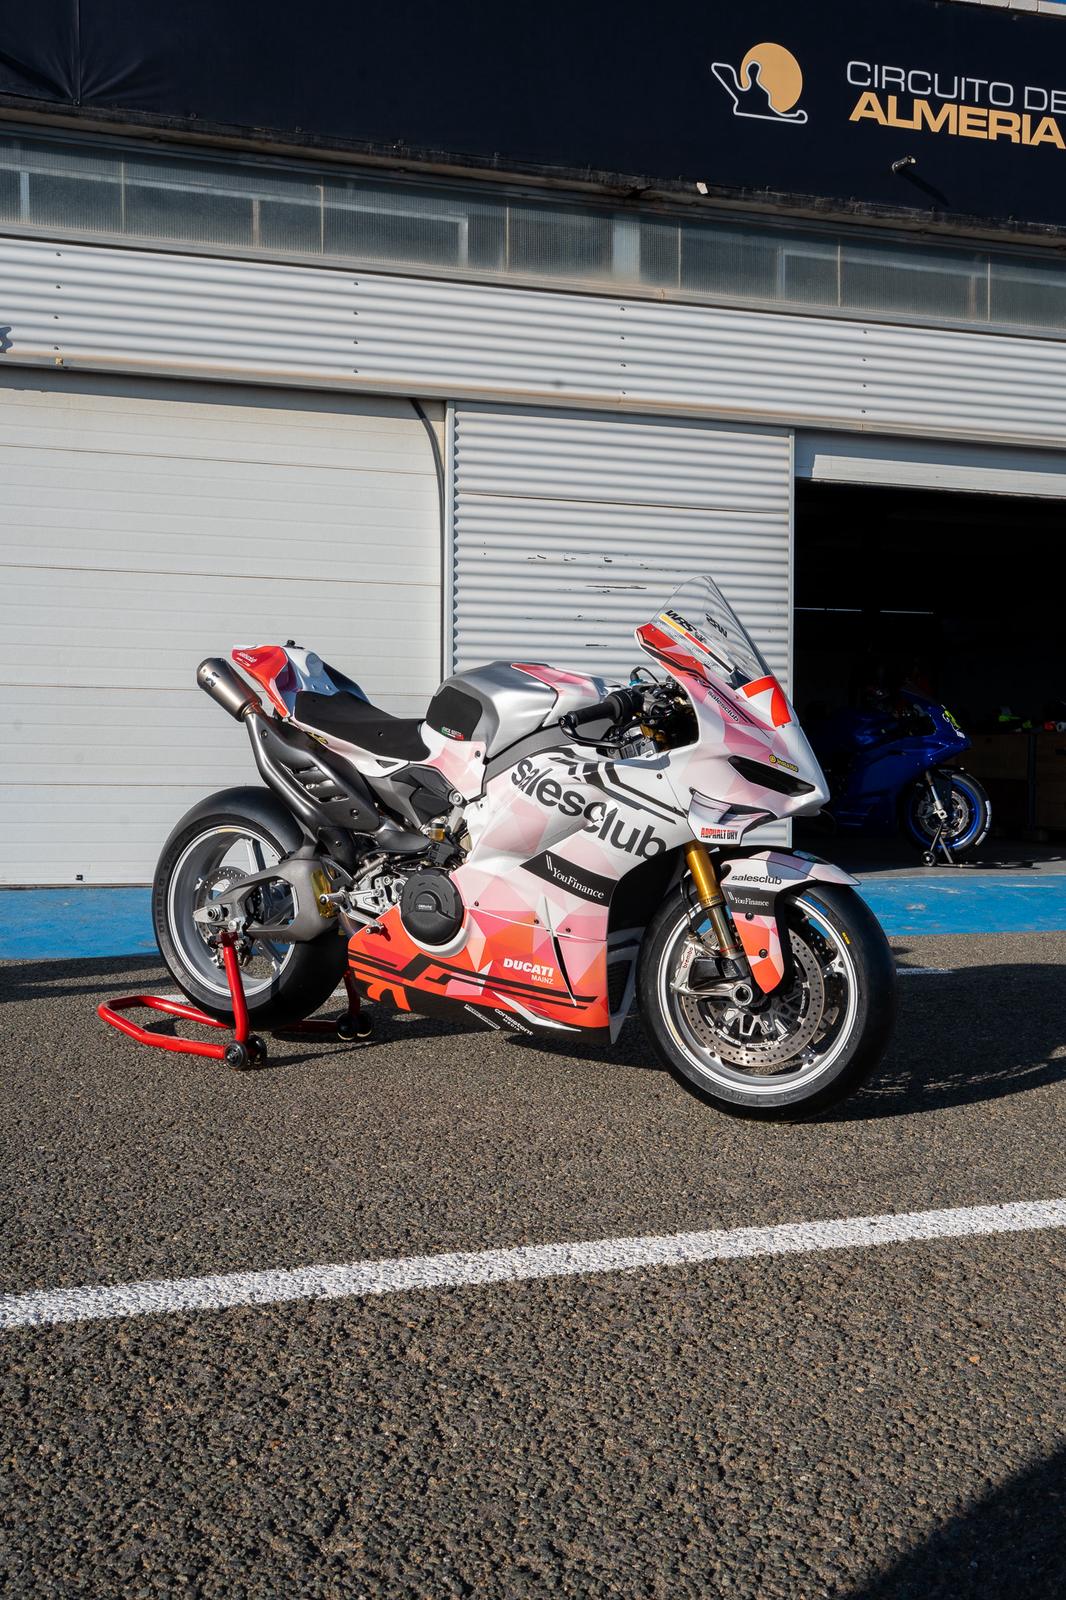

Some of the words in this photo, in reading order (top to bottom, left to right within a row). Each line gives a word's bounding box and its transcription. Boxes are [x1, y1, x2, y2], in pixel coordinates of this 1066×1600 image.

[846, 60, 1014, 107] CIRCUITO
[1024, 86, 1066, 115] DE
[848, 91, 1066, 149] ALMERIA
[665, 609, 697, 632] WRS
[707, 690, 739, 722] salesclub
[553, 867, 605, 899] YouFinance
[731, 874, 782, 885] salesclub
[735, 897, 770, 907] YouFinance
[503, 957, 554, 977] DUCATI
[682, 947, 694, 969] brembo
[531, 974, 554, 985] MAINZ
[494, 1008, 534, 1036] consistent
